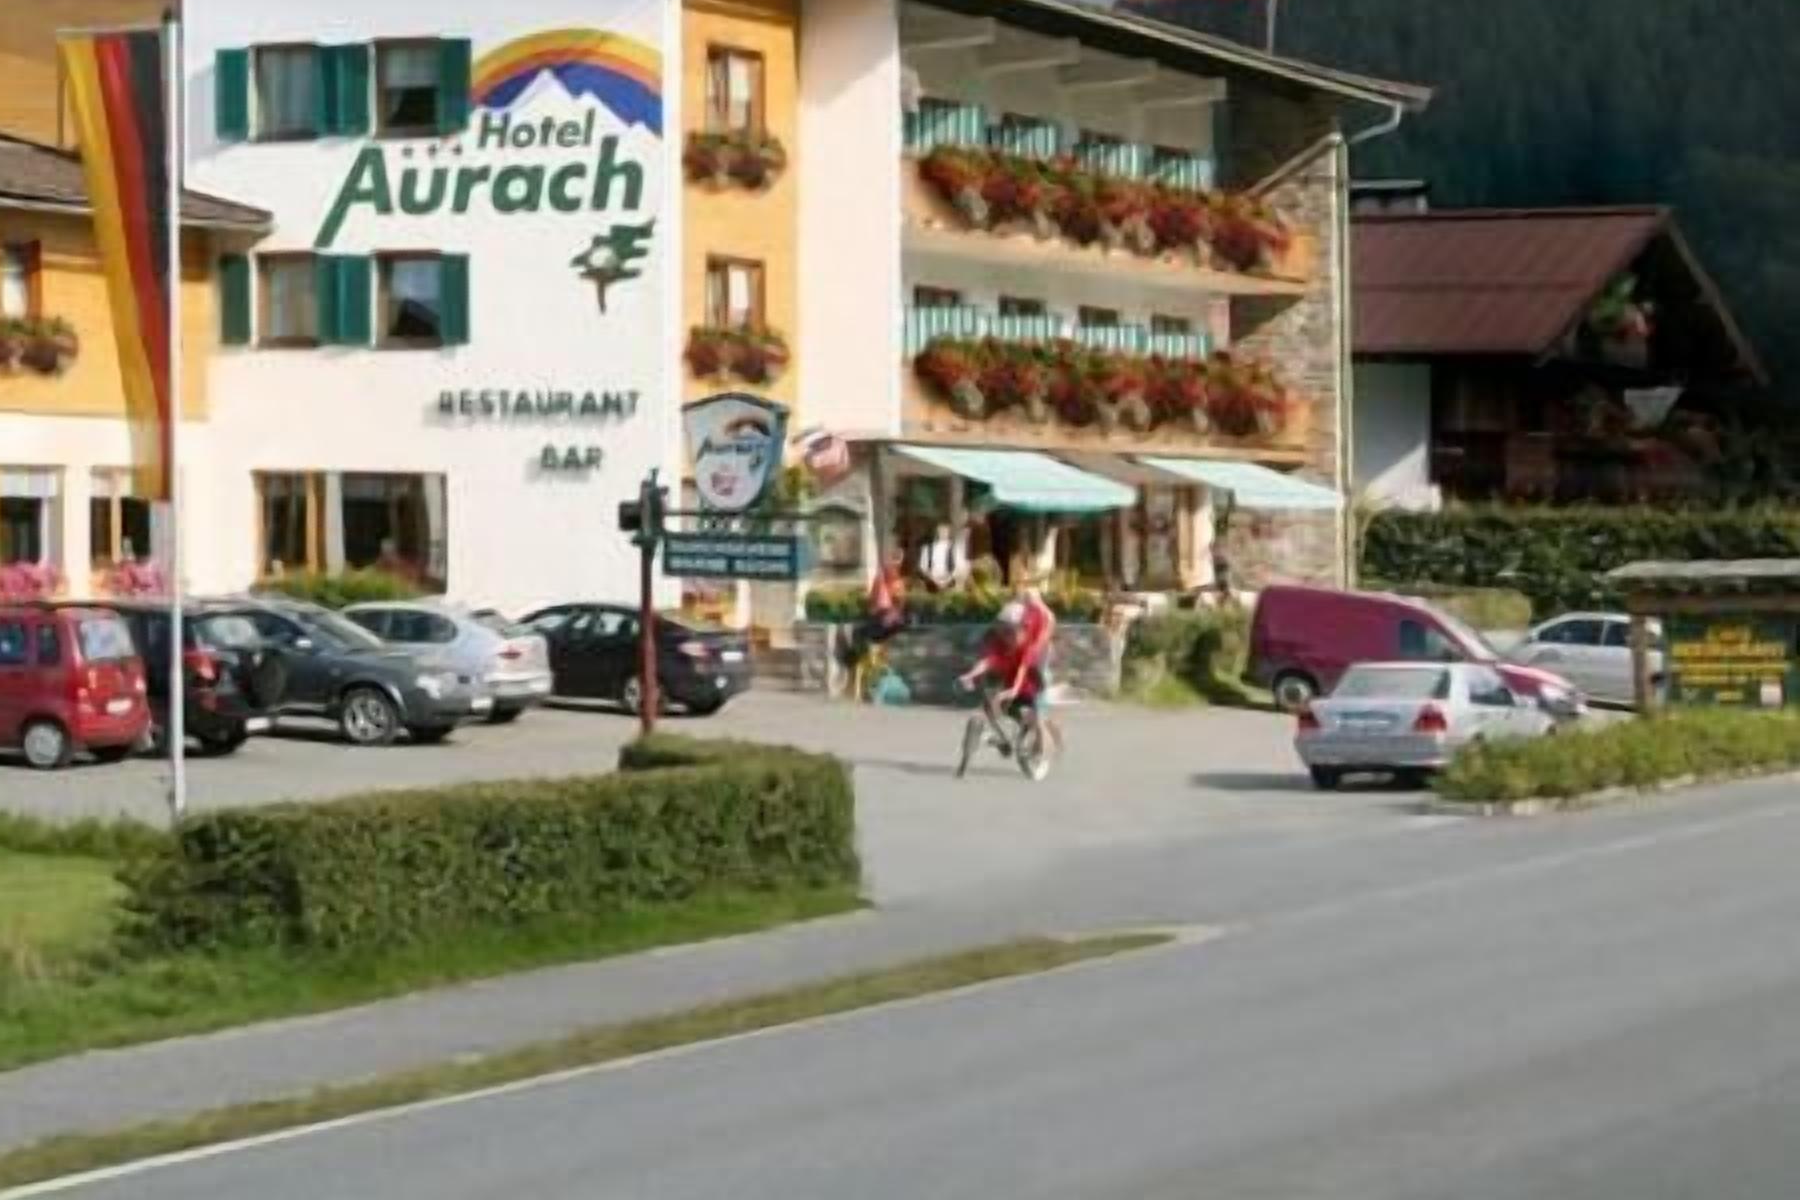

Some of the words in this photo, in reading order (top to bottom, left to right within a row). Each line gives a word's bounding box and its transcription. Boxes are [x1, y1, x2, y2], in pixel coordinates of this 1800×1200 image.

[477, 108, 596, 149] Hotel
[314, 136, 644, 249] Aurach
[439, 388, 639, 416] RESTAURANT
[540, 442, 602, 470] BAR
